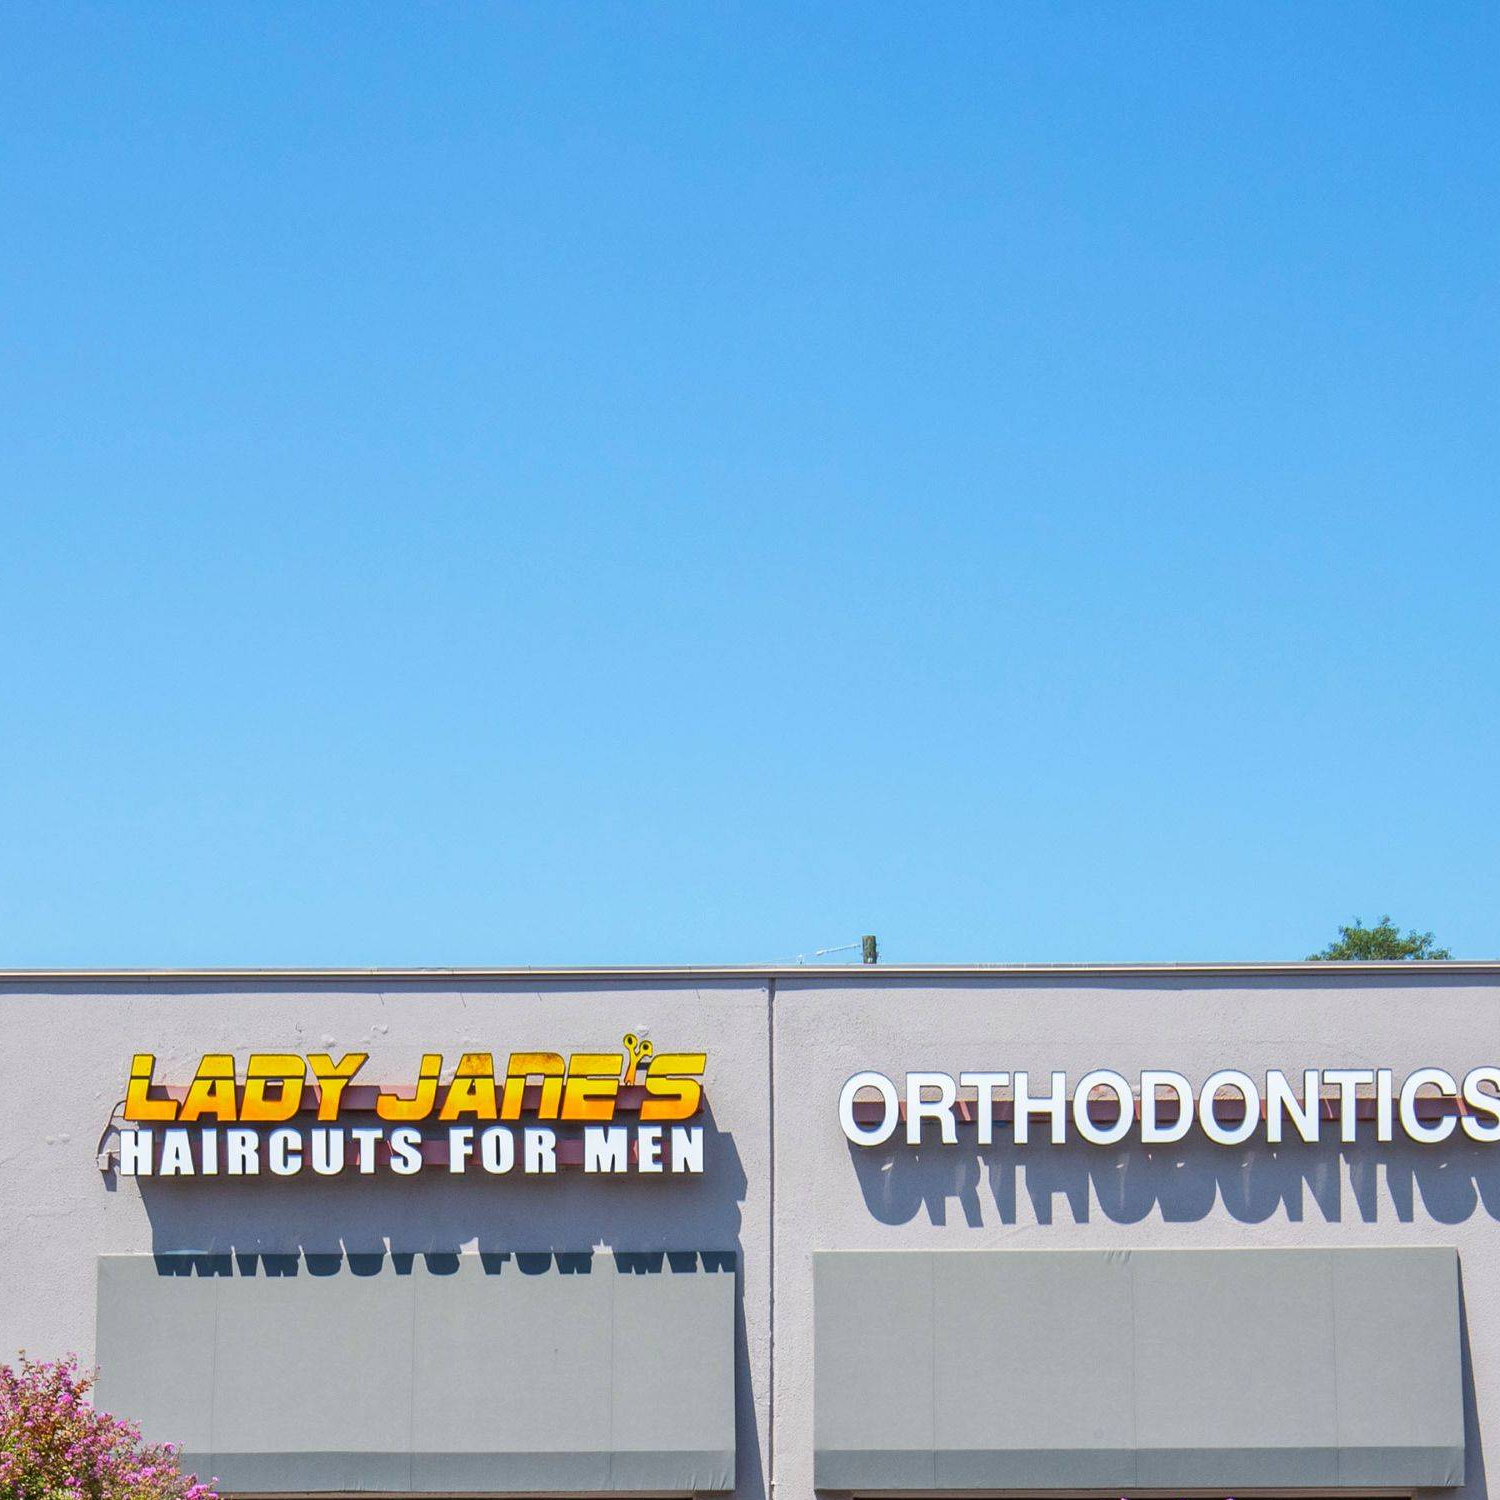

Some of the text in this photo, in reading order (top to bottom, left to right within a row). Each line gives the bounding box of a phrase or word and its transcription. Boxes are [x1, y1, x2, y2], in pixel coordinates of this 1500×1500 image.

[123, 1034, 707, 1122] LADY JANE'S
[119, 1126, 704, 1176] HAIRCUTS FOR MEN
